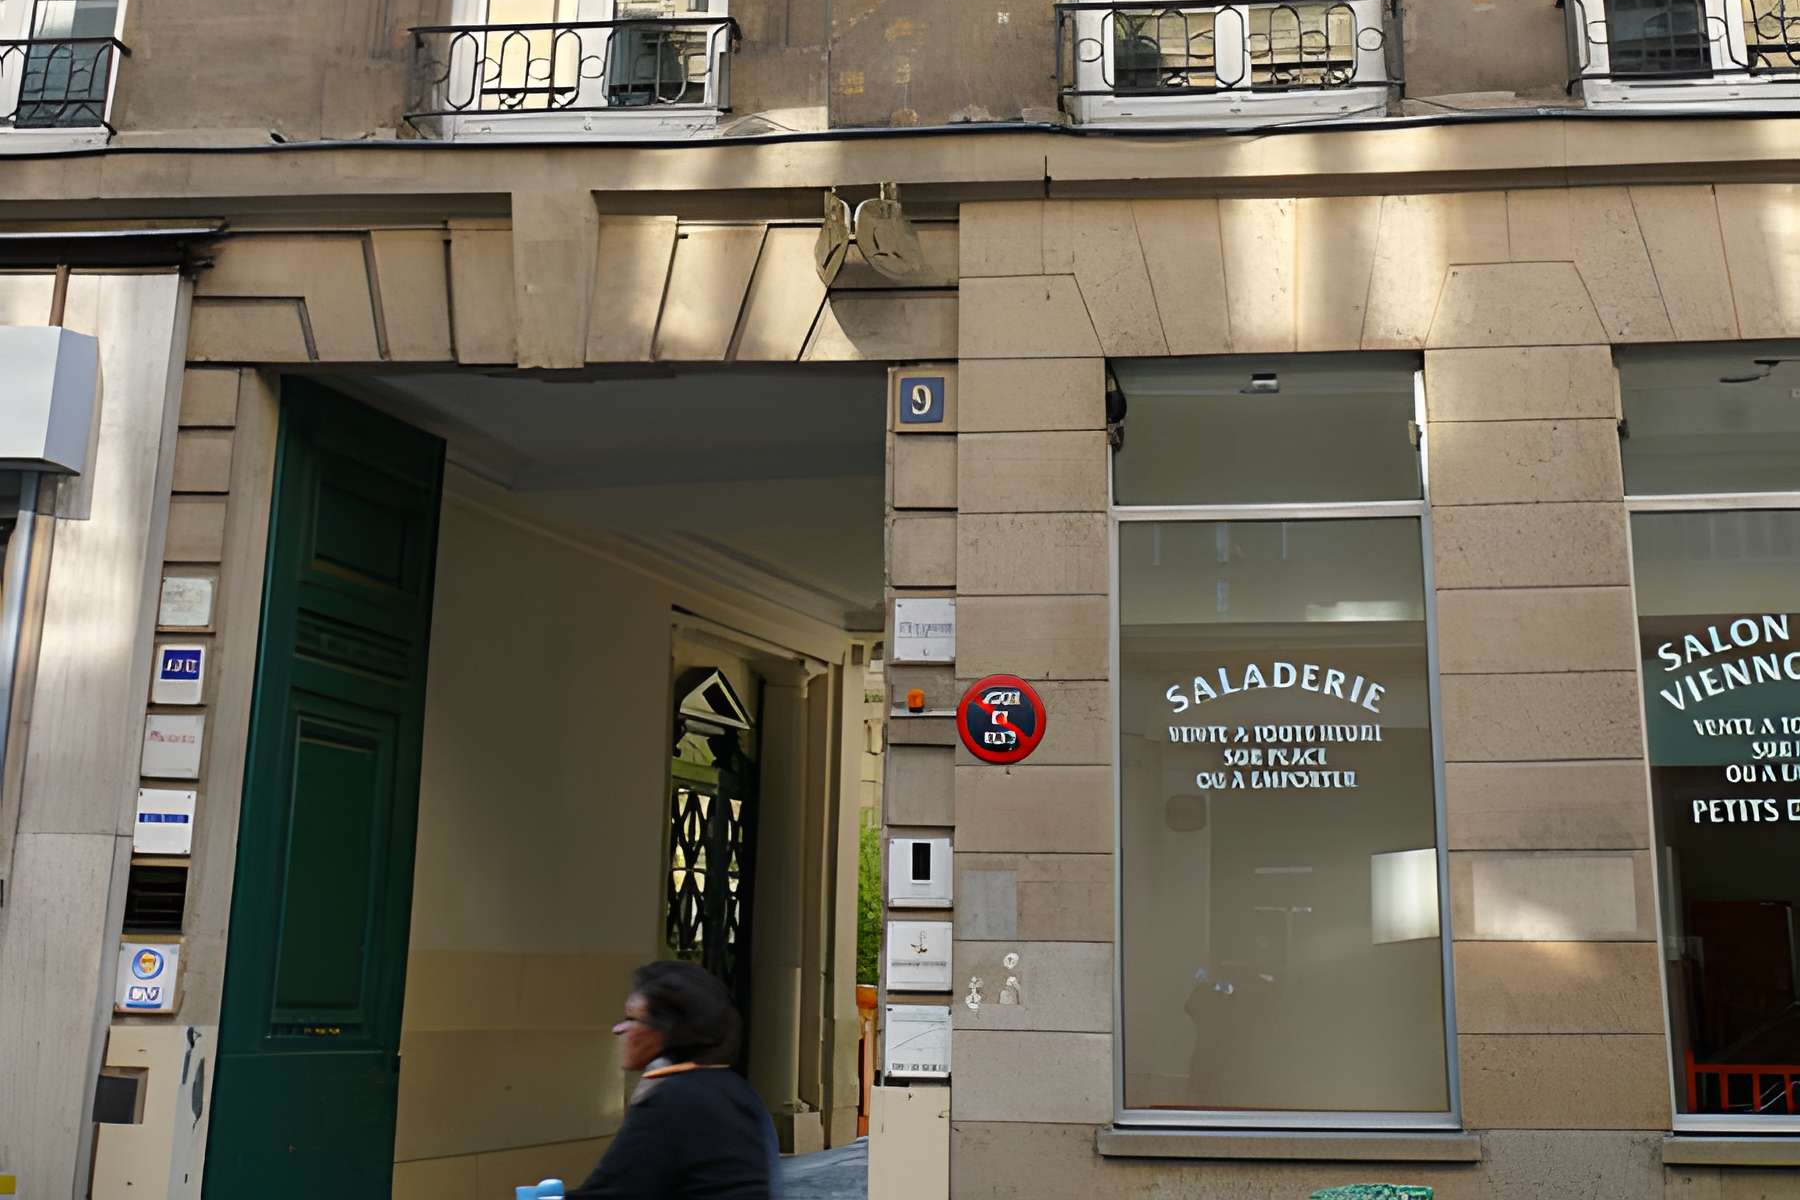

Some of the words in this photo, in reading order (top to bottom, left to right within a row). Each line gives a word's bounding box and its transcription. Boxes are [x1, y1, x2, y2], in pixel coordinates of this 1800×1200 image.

[912, 384, 932, 415] 9
[1657, 614, 1790, 673] SALON
[1165, 661, 1387, 714] SALADERIE
[1692, 798, 1780, 823] PETITS
